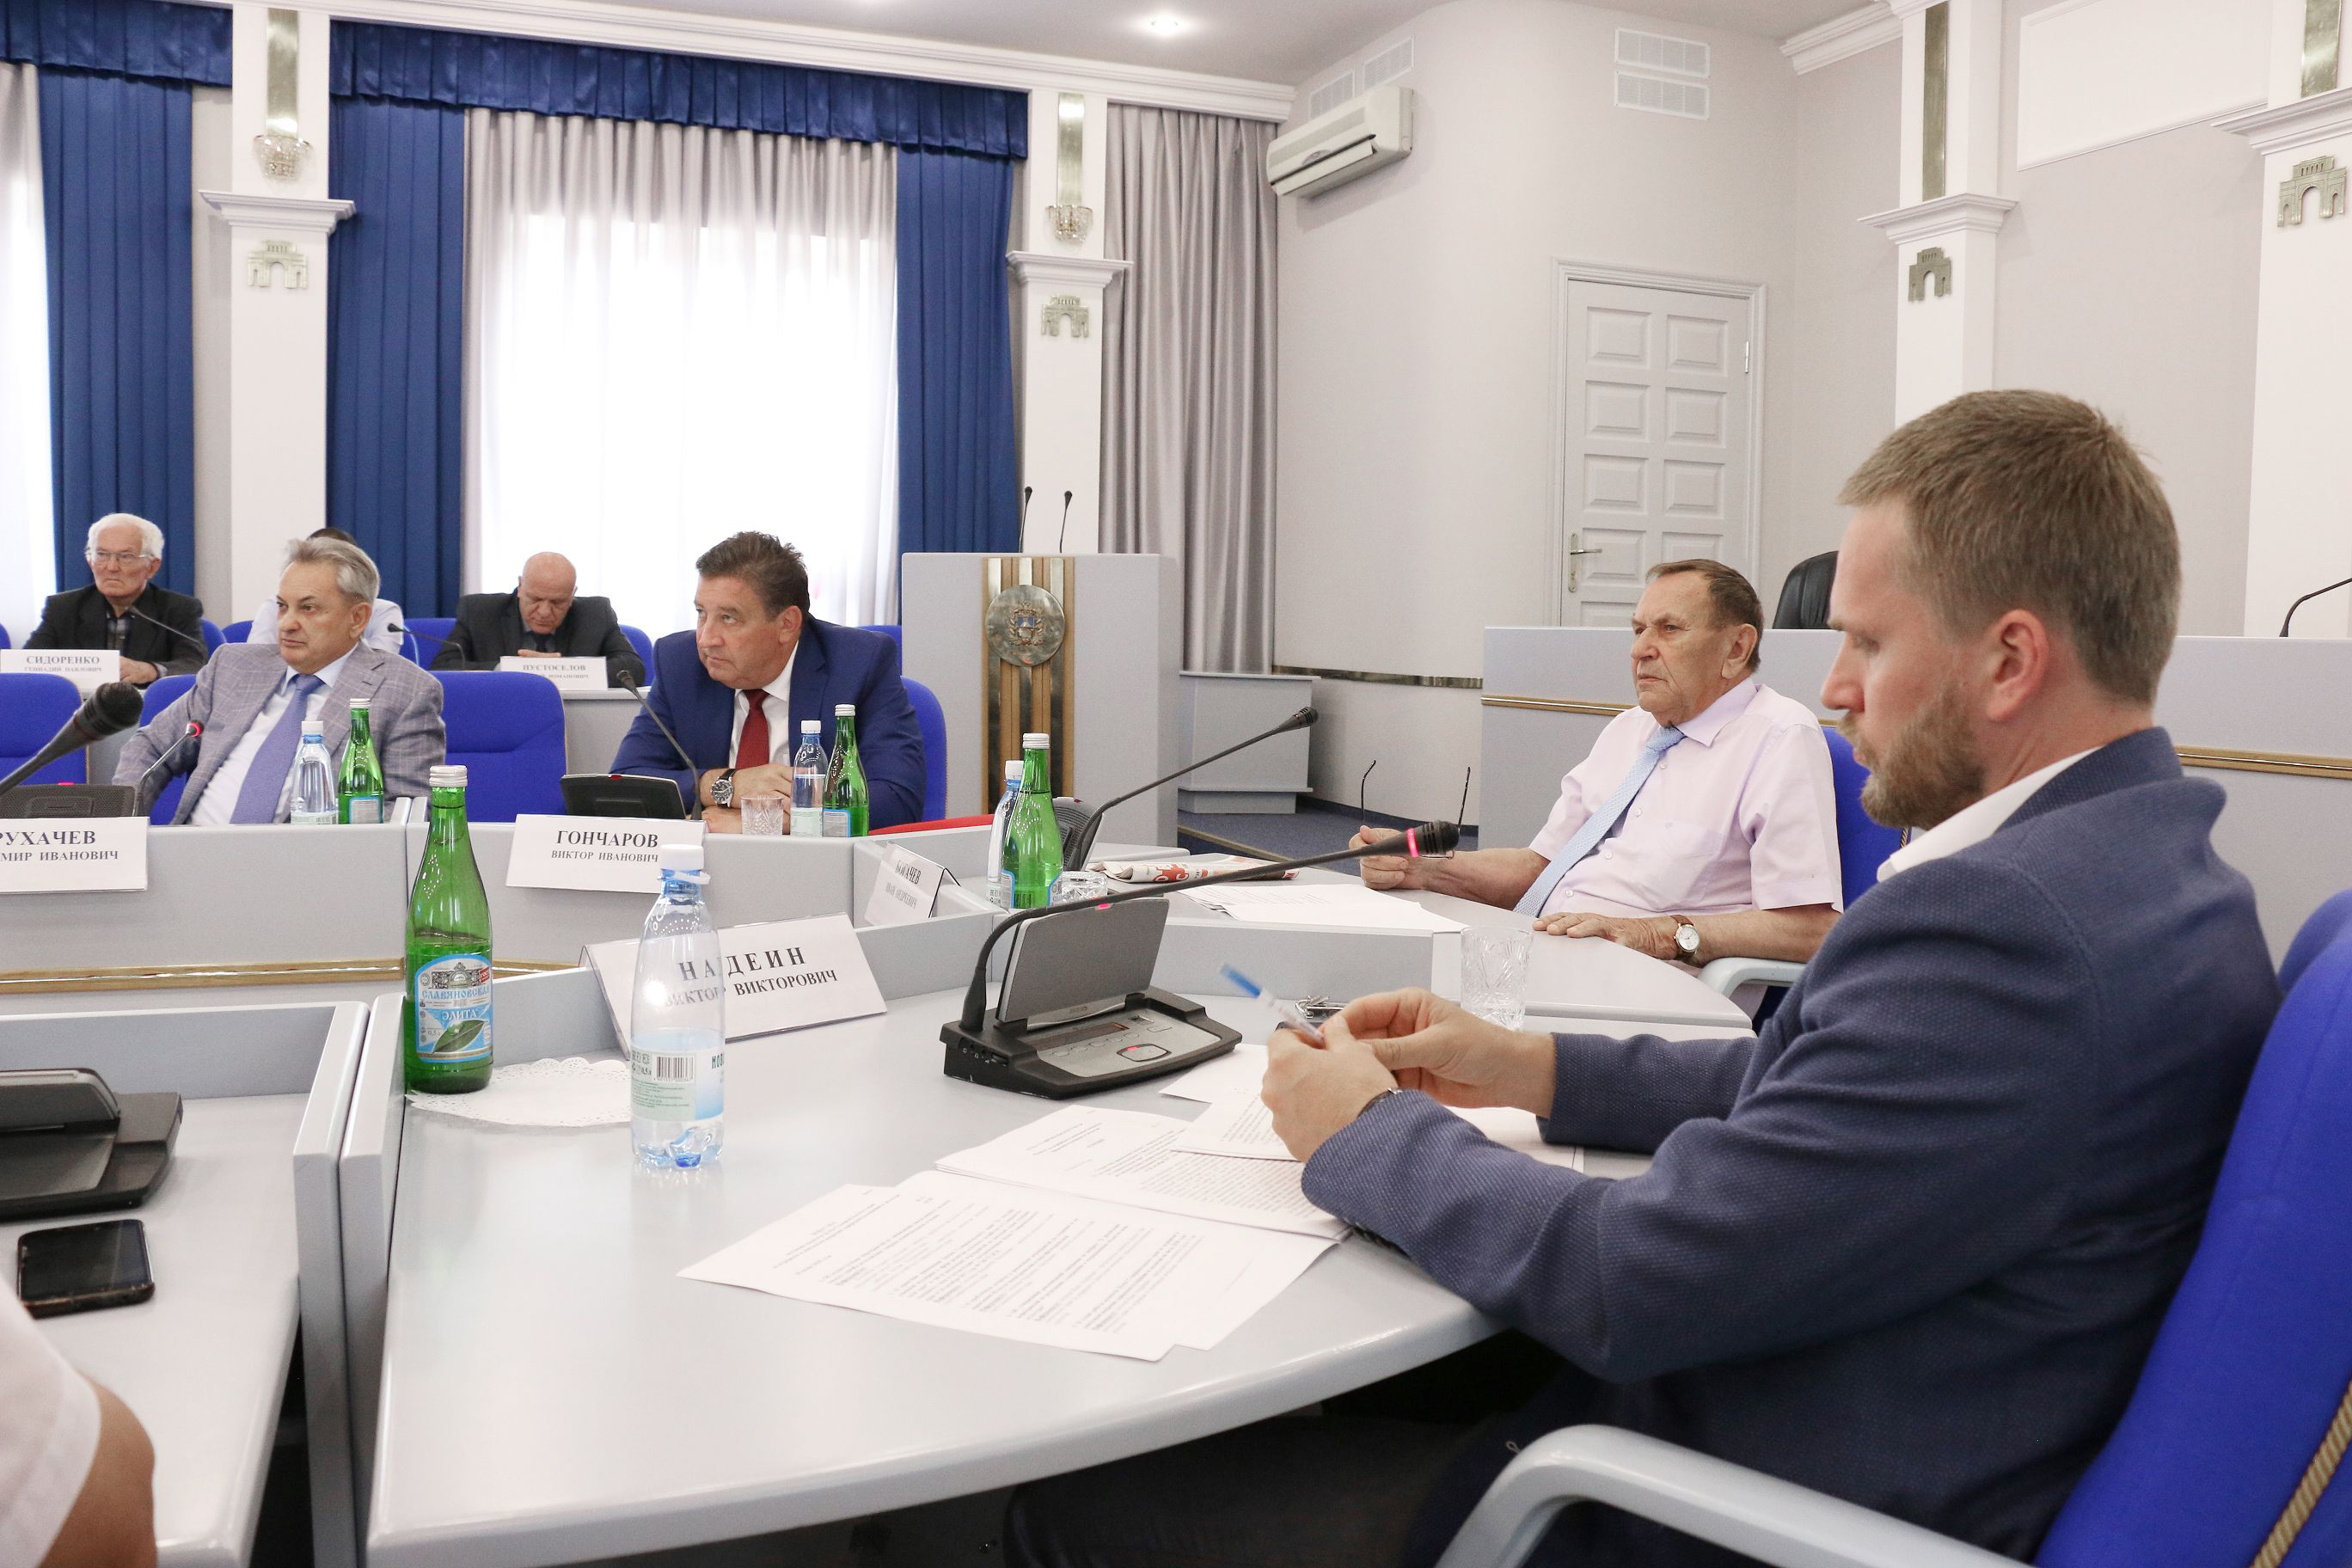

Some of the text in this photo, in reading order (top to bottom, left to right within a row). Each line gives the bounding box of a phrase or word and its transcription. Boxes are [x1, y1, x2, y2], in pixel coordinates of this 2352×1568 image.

[26, 655, 100, 665] СИДОРЕНКО
[0, 830, 96, 845] УХАЧЕВ
[556, 830, 658, 848] ГОНЧАРОВ
[40, 850, 118, 861] ИВАНОВИЧ
[551, 849, 658, 863] ВИКТОР ИВАНОВИЧ
[678, 946, 806, 982] НАДЕИН
[734, 969, 838, 996] ВИКТОРОВИЧ
[442, 1008, 478, 1020] ЭЛИТА
